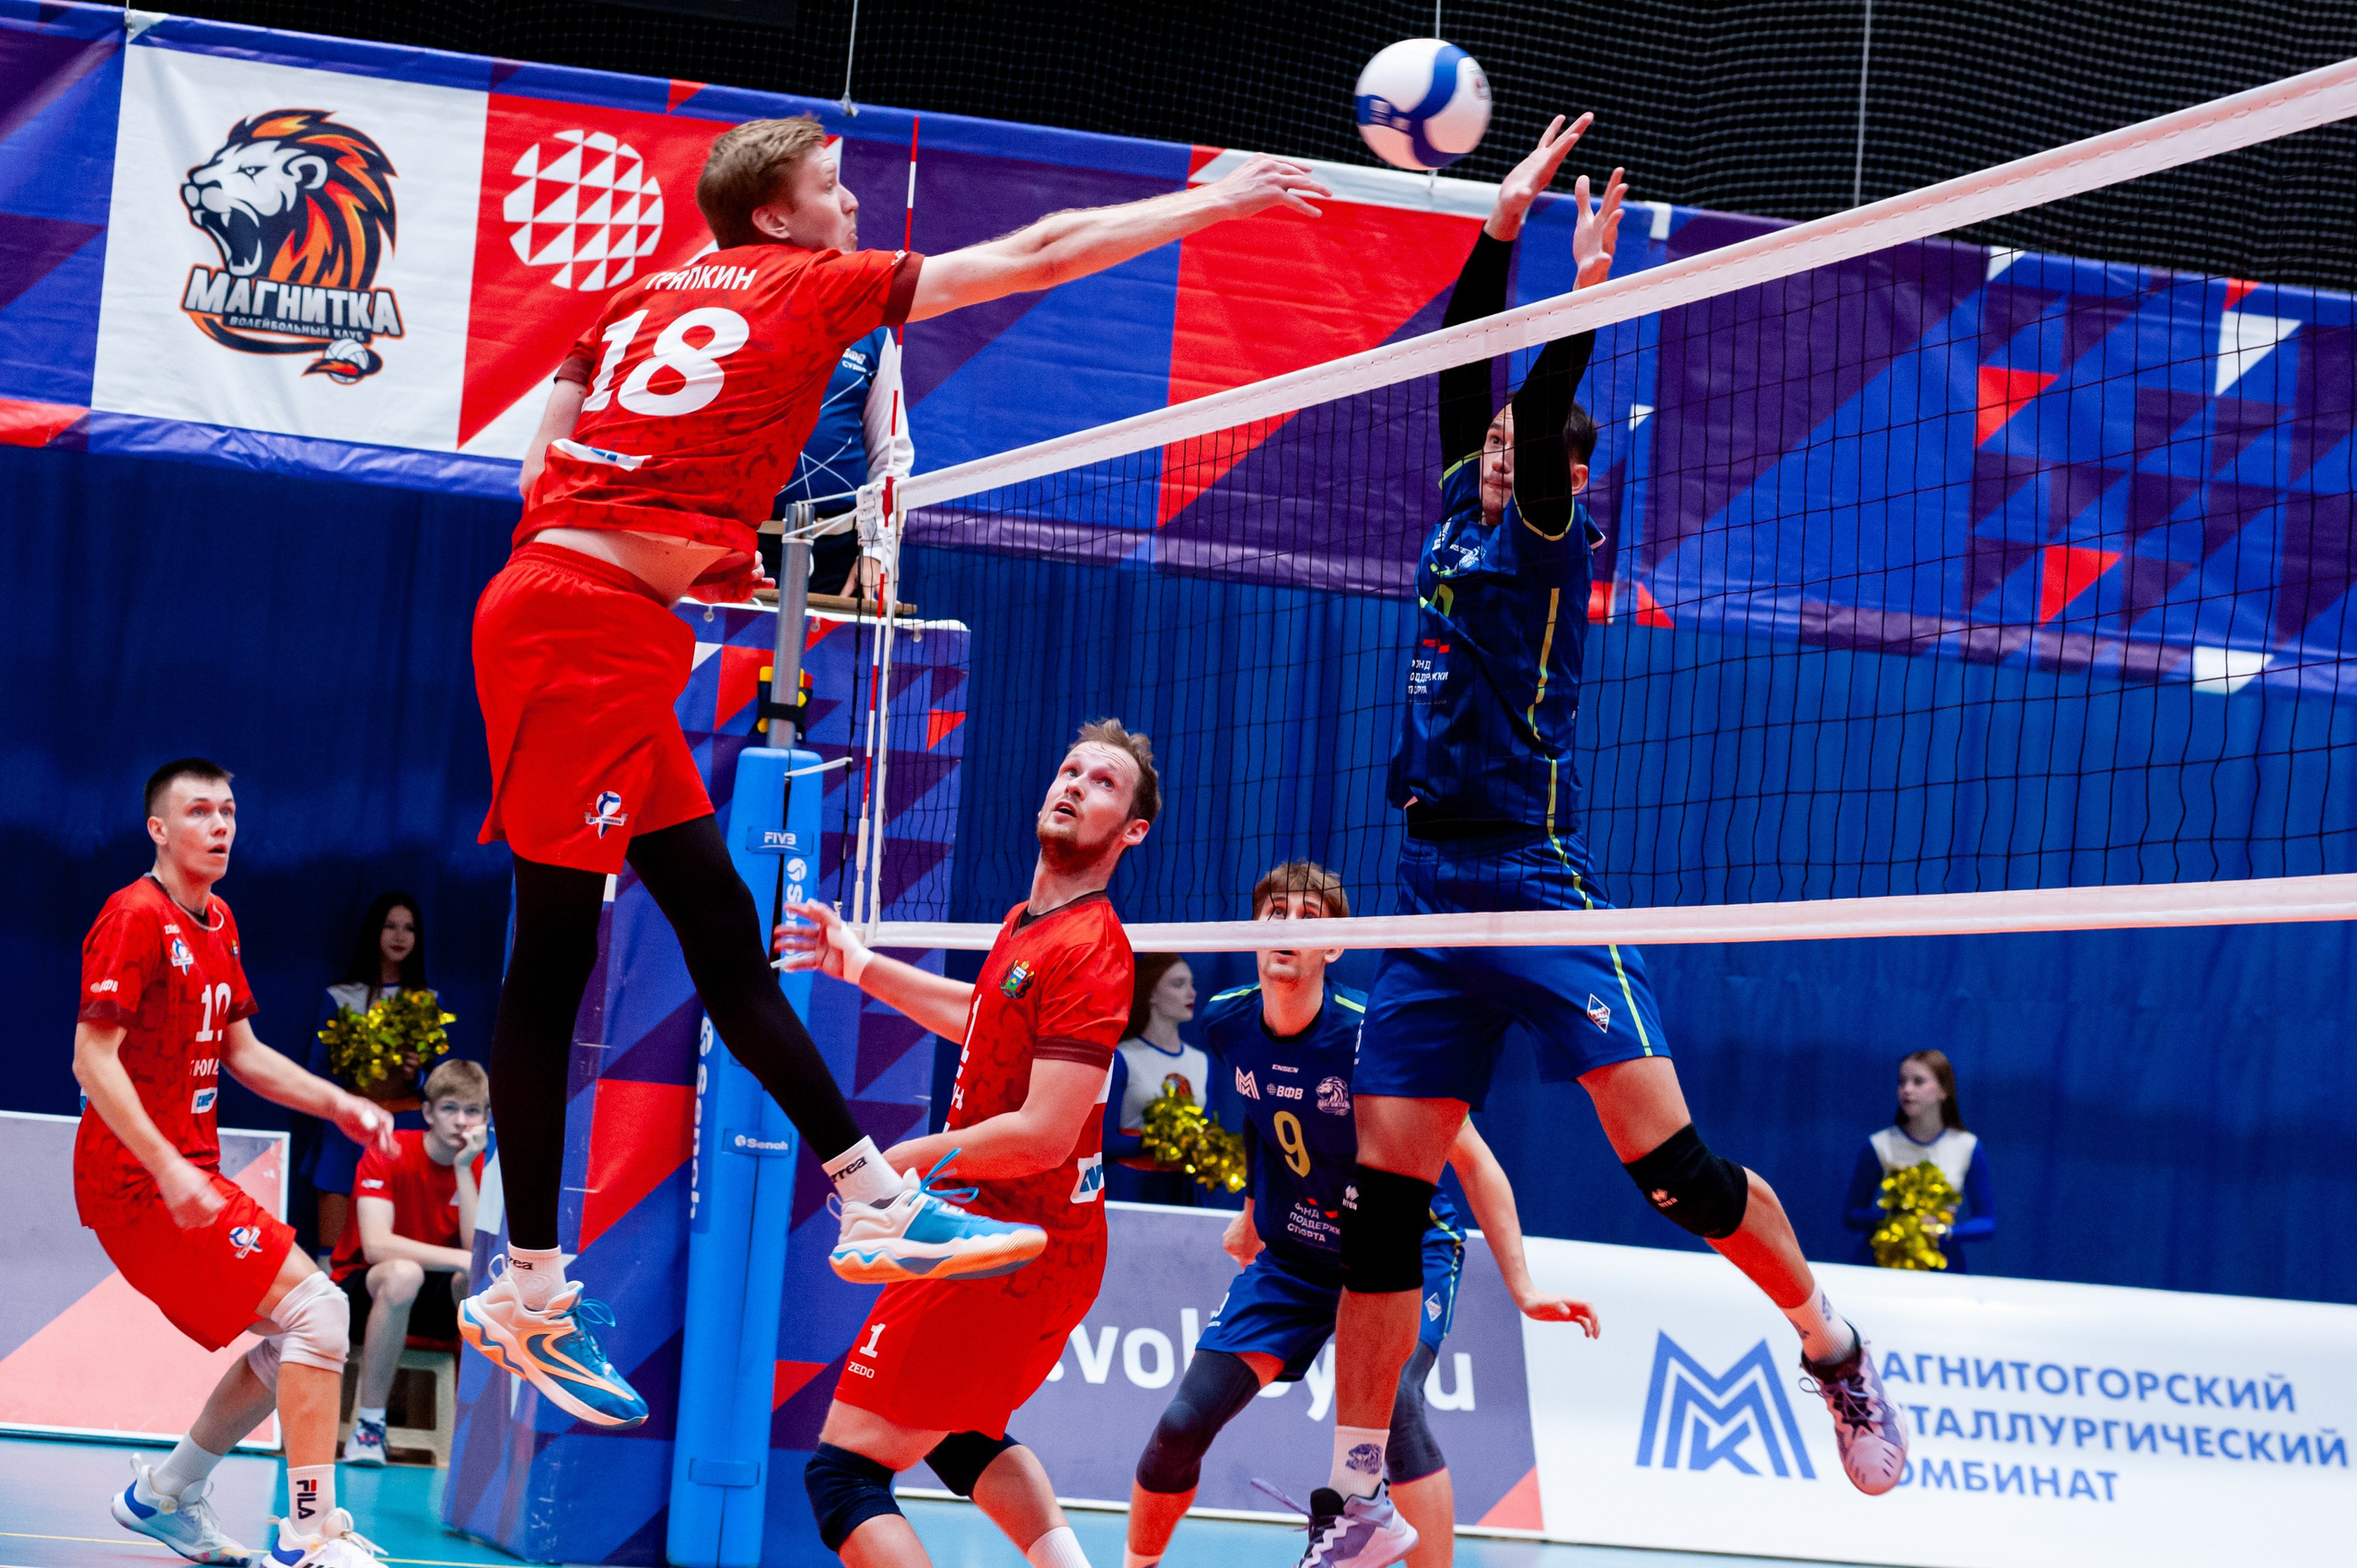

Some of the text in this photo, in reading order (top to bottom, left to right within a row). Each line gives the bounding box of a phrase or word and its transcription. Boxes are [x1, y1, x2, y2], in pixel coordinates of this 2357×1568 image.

[184, 267, 402, 336] МАГНИТКА
[230, 315, 365, 341] ВОЛЕЙБОЛЬНЫЙ КЛУБ
[581, 307, 749, 417] 18
[1276, 1085, 1304, 1100] ВФВ
[746, 1137, 788, 1151] Senoh
[1273, 1110, 1311, 1178] 9
[859, 1323, 886, 1358] 1
[848, 1361, 875, 1379] ZEDO
[1882, 1352, 2295, 1412] АГНИТОГОРСКИЙ
[1900, 1404, 2348, 1467] ТАЛЛУРГИЧЕСКИЙ
[296, 1480, 317, 1519] FILA
